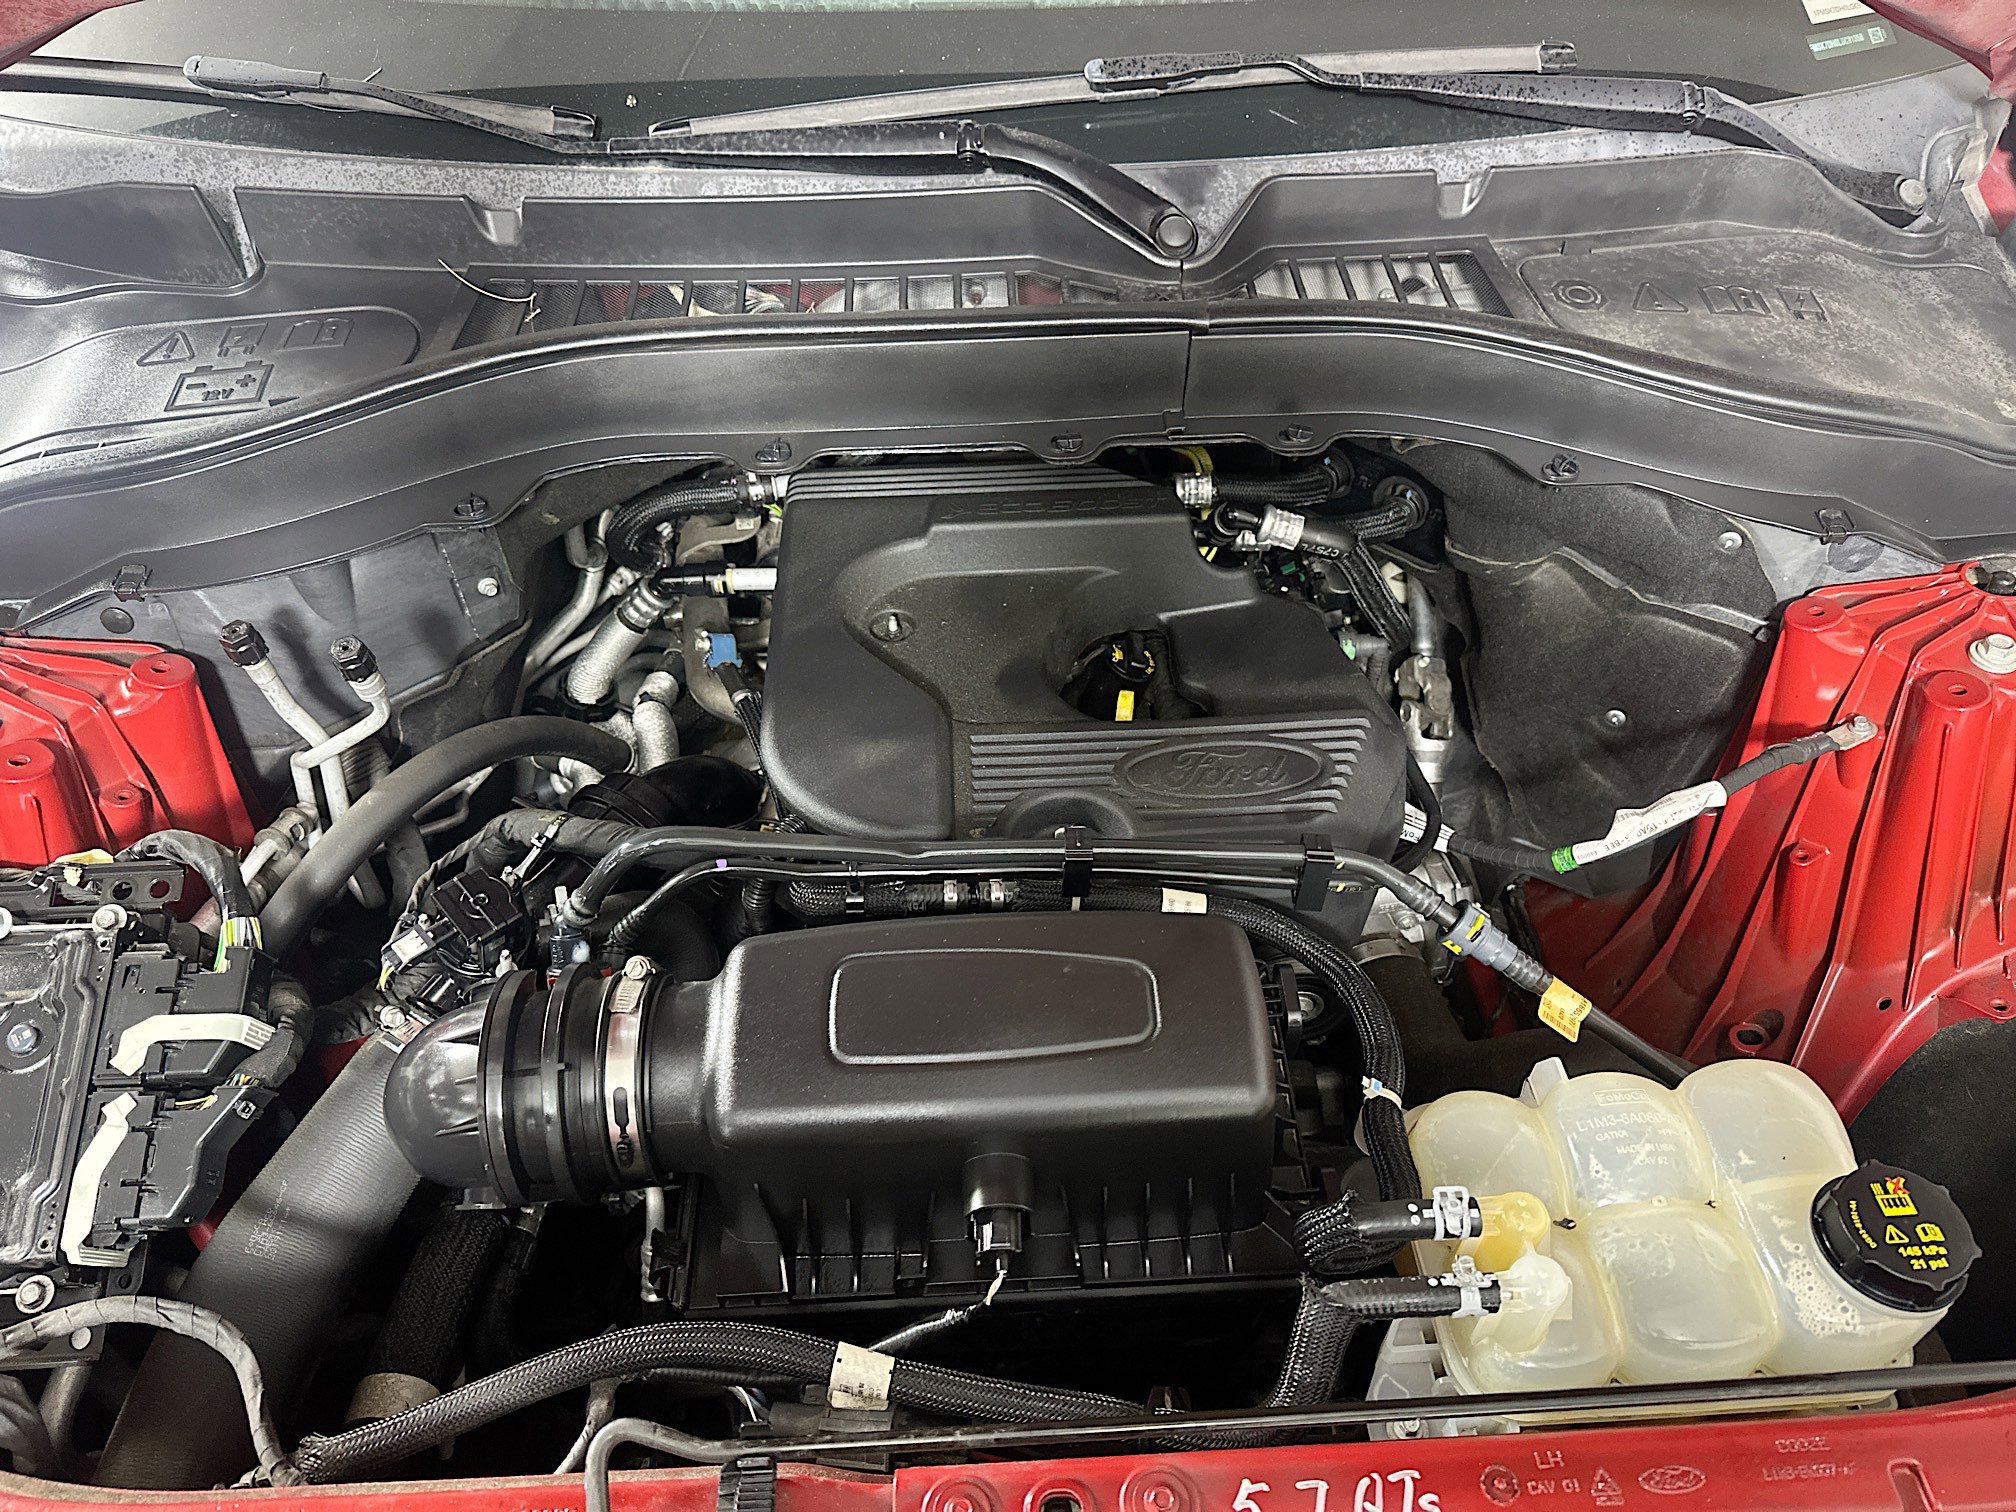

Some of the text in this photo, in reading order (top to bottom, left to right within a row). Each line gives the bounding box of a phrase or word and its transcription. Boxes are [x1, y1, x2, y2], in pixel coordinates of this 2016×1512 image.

[201, 388, 235, 402] 12V
[1163, 748, 1289, 790] Ford
[1897, 1246, 1922, 1258] 145
[1909, 1258, 1928, 1271] 21
[1533, 1450, 1566, 1470] LH
